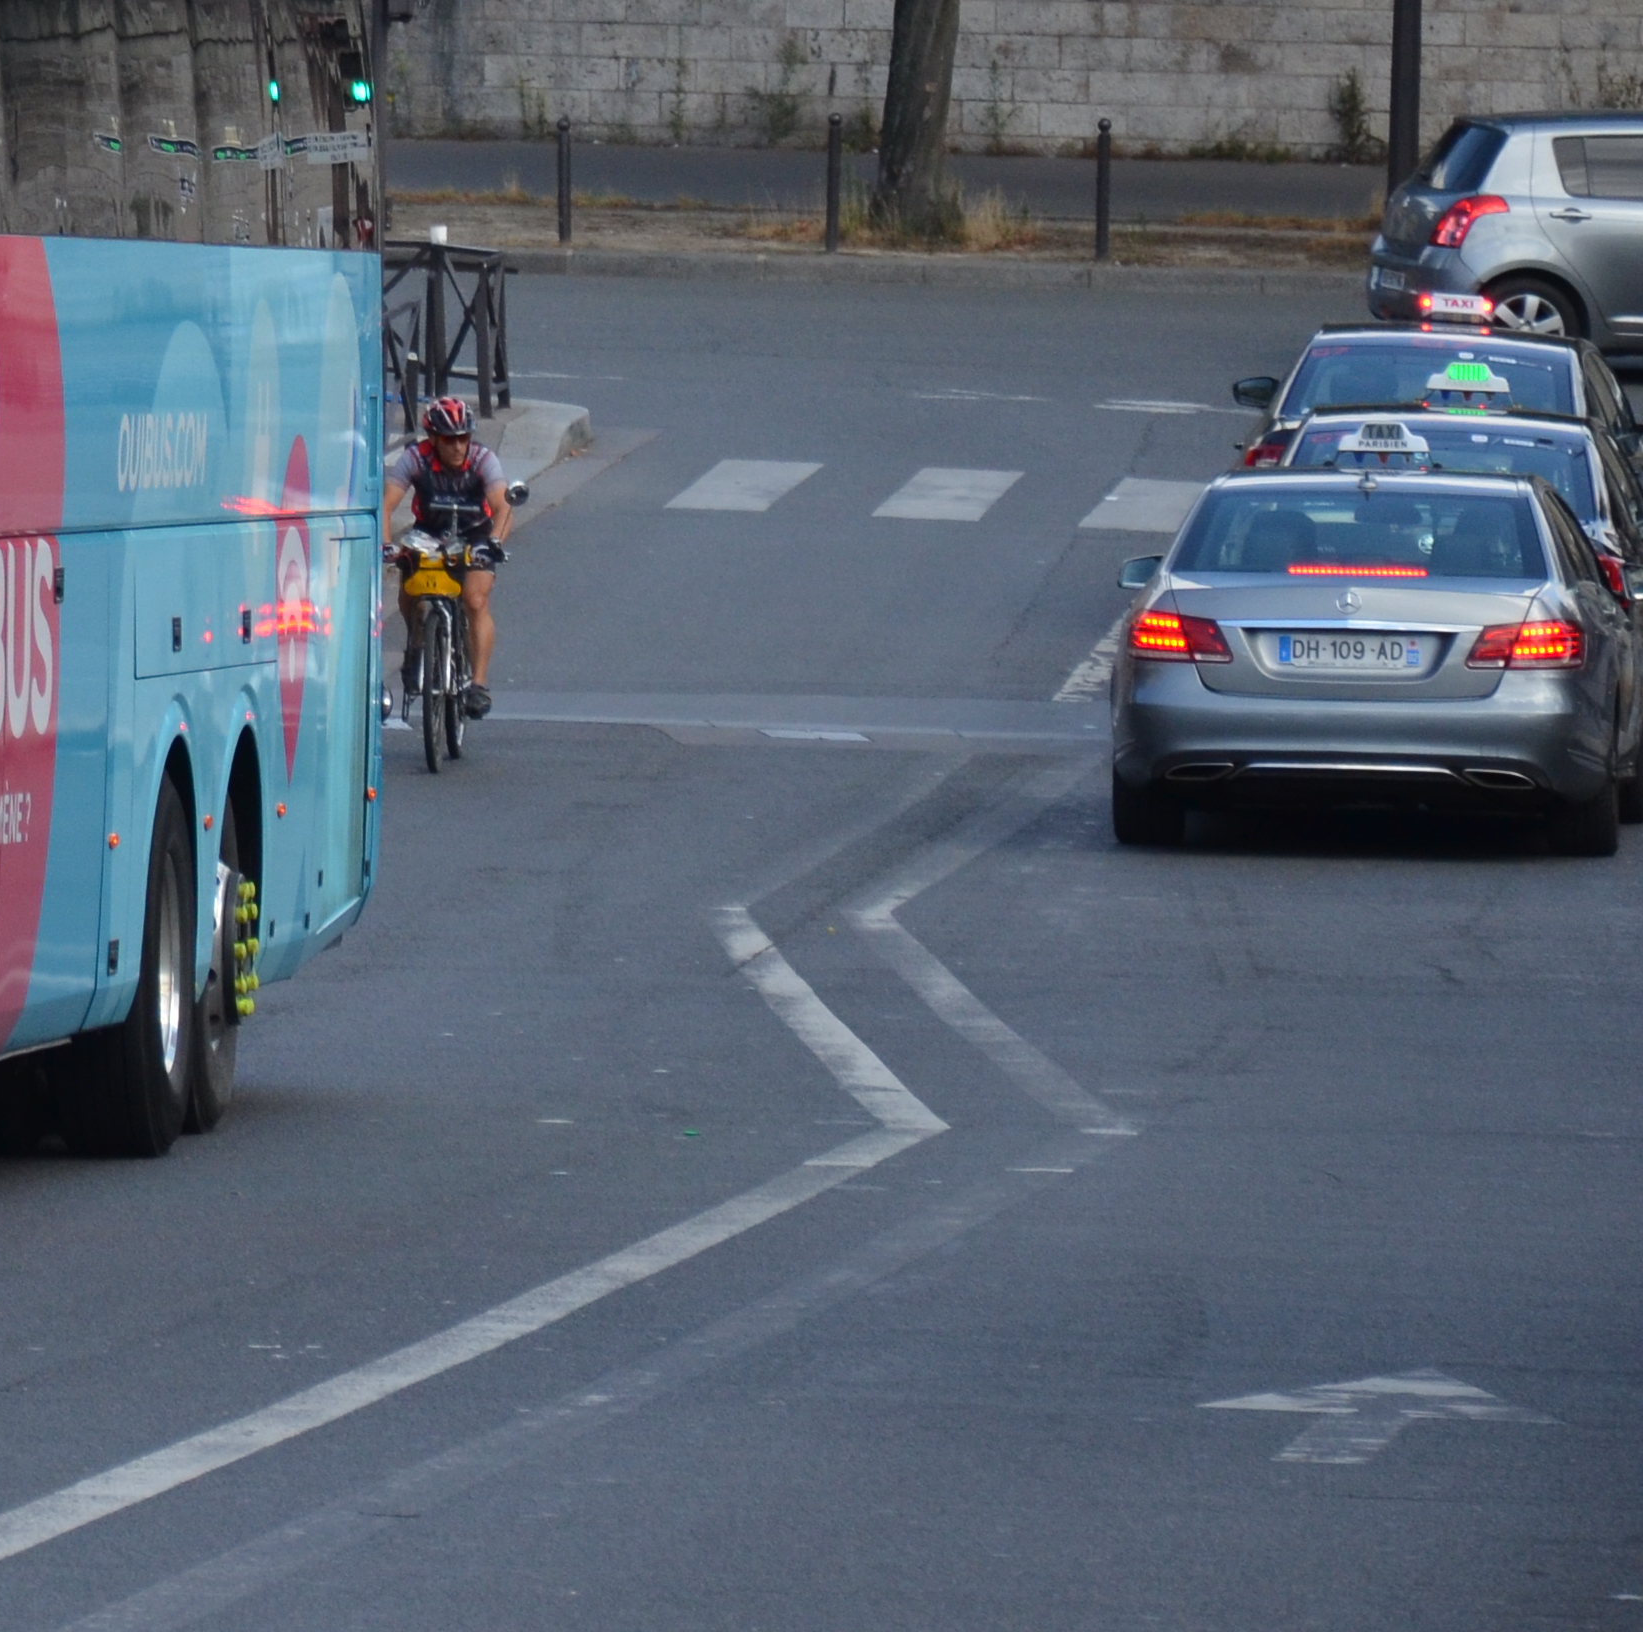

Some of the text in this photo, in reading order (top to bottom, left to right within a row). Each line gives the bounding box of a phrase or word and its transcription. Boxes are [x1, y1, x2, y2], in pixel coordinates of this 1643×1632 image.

[1442, 298, 1474, 308] TAXI
[1367, 423, 1401, 440] TAXI
[1358, 440, 1408, 449] PARISIEN
[118, 413, 208, 491] OUIBUS.COM
